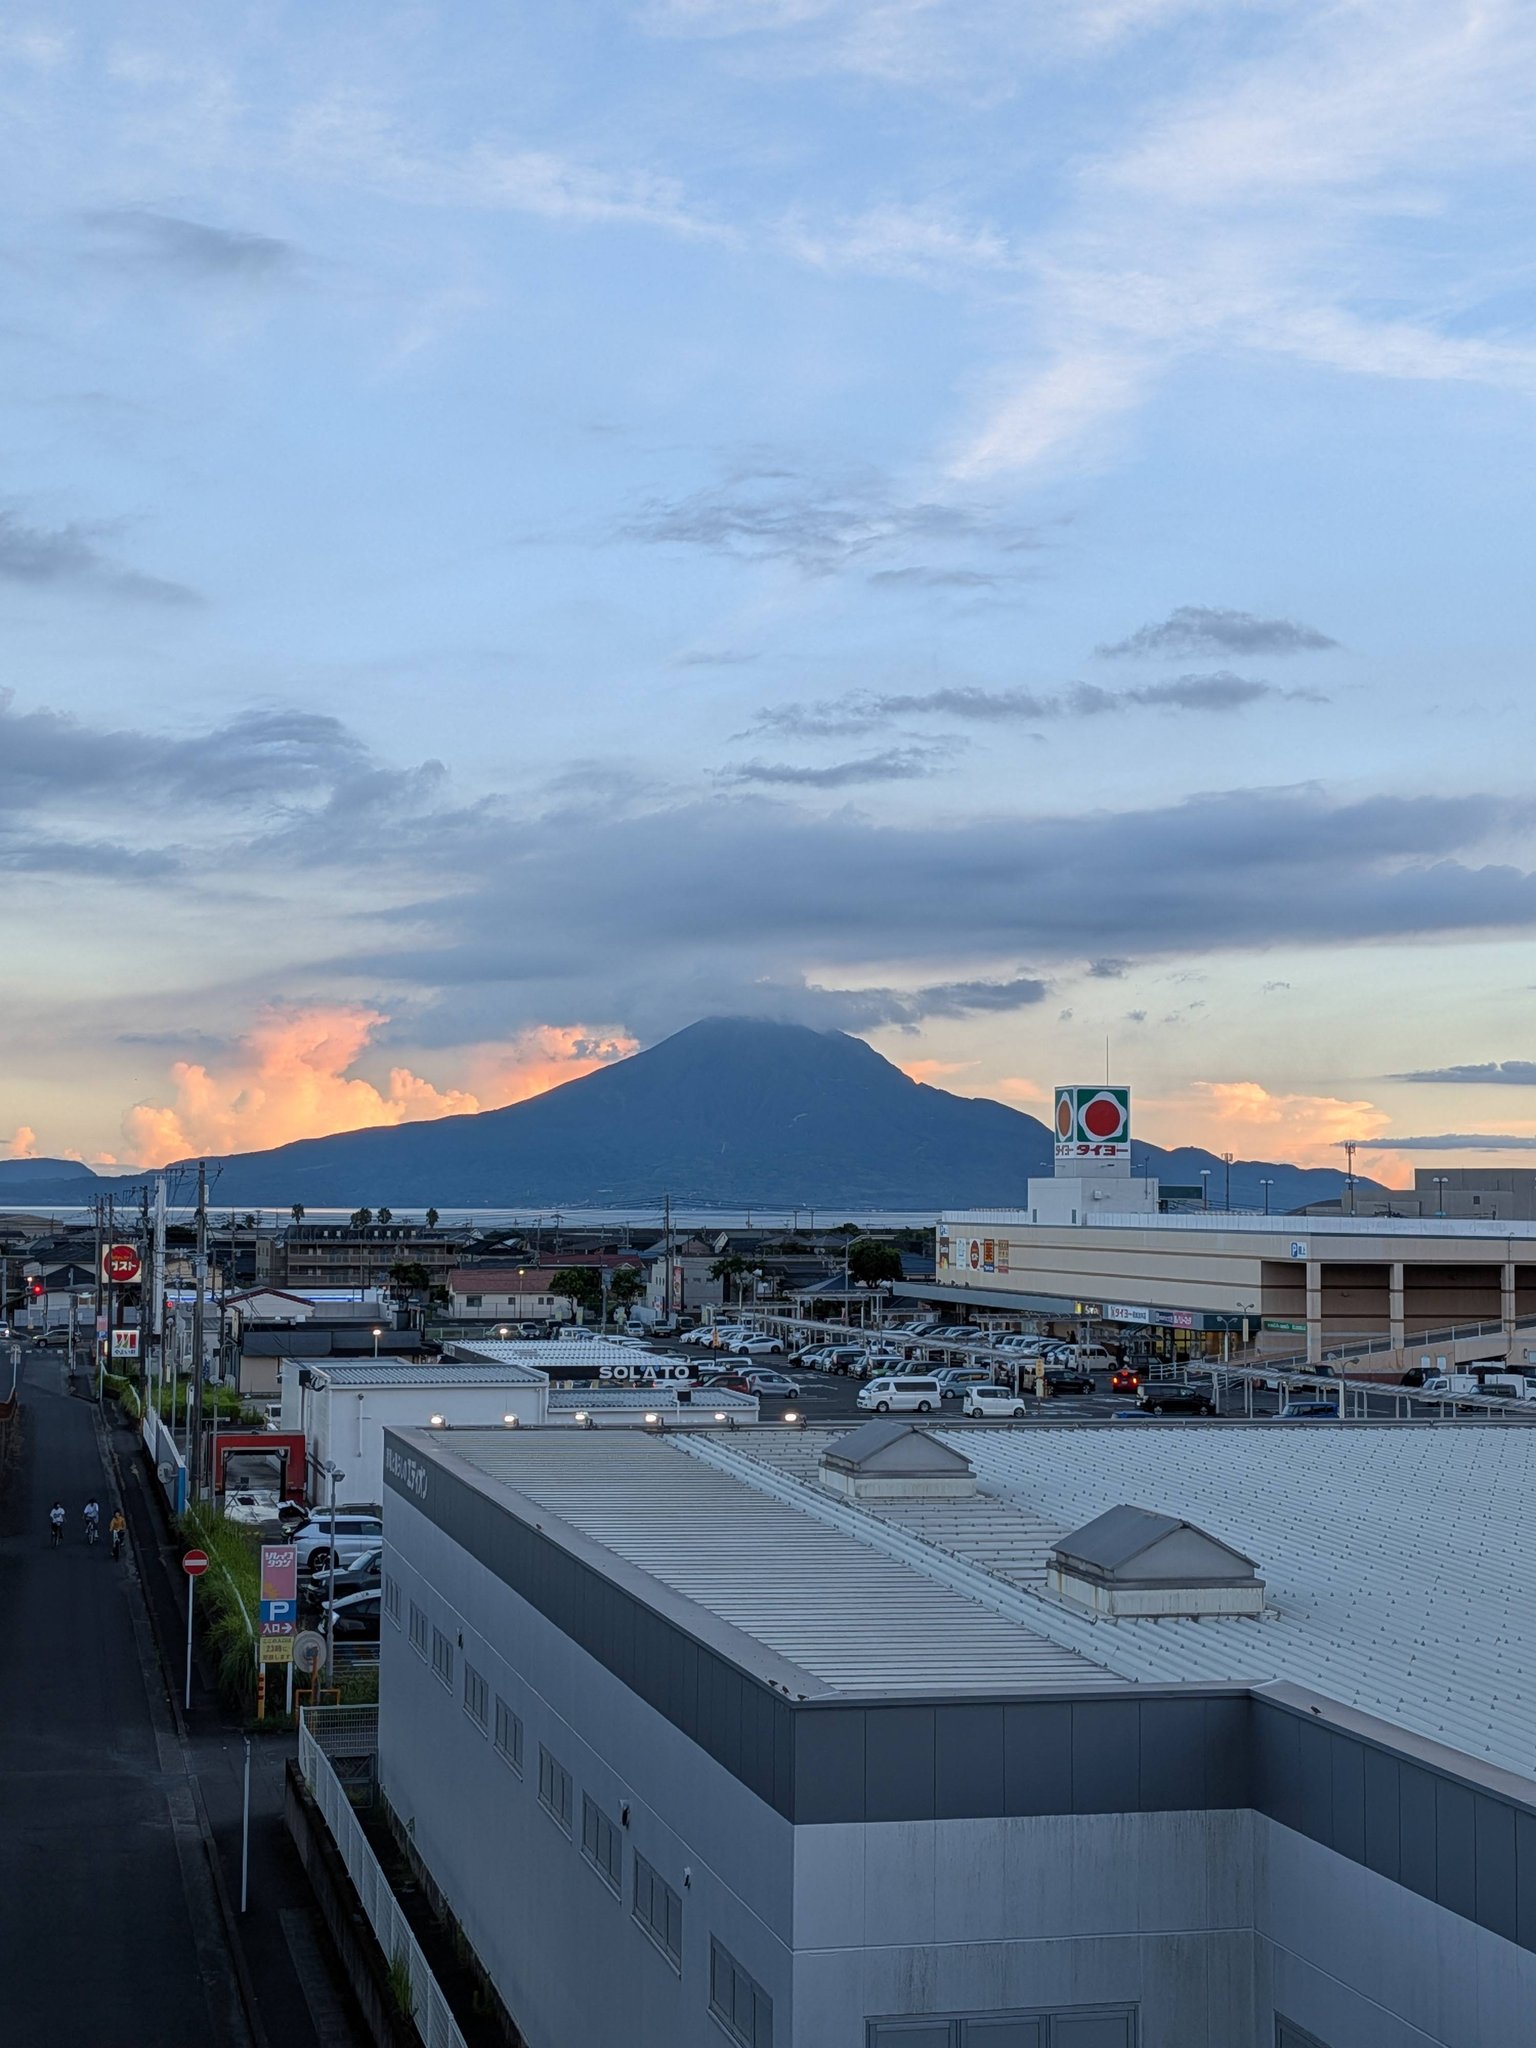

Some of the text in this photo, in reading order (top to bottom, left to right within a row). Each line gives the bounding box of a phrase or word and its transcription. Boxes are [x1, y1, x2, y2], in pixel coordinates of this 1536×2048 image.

[1076, 1144, 1129, 1156] タイヨー
[599, 1366, 690, 1379] SOLATO
[269, 1602, 290, 1621] P
[263, 1623, 280, 1634] 入口
